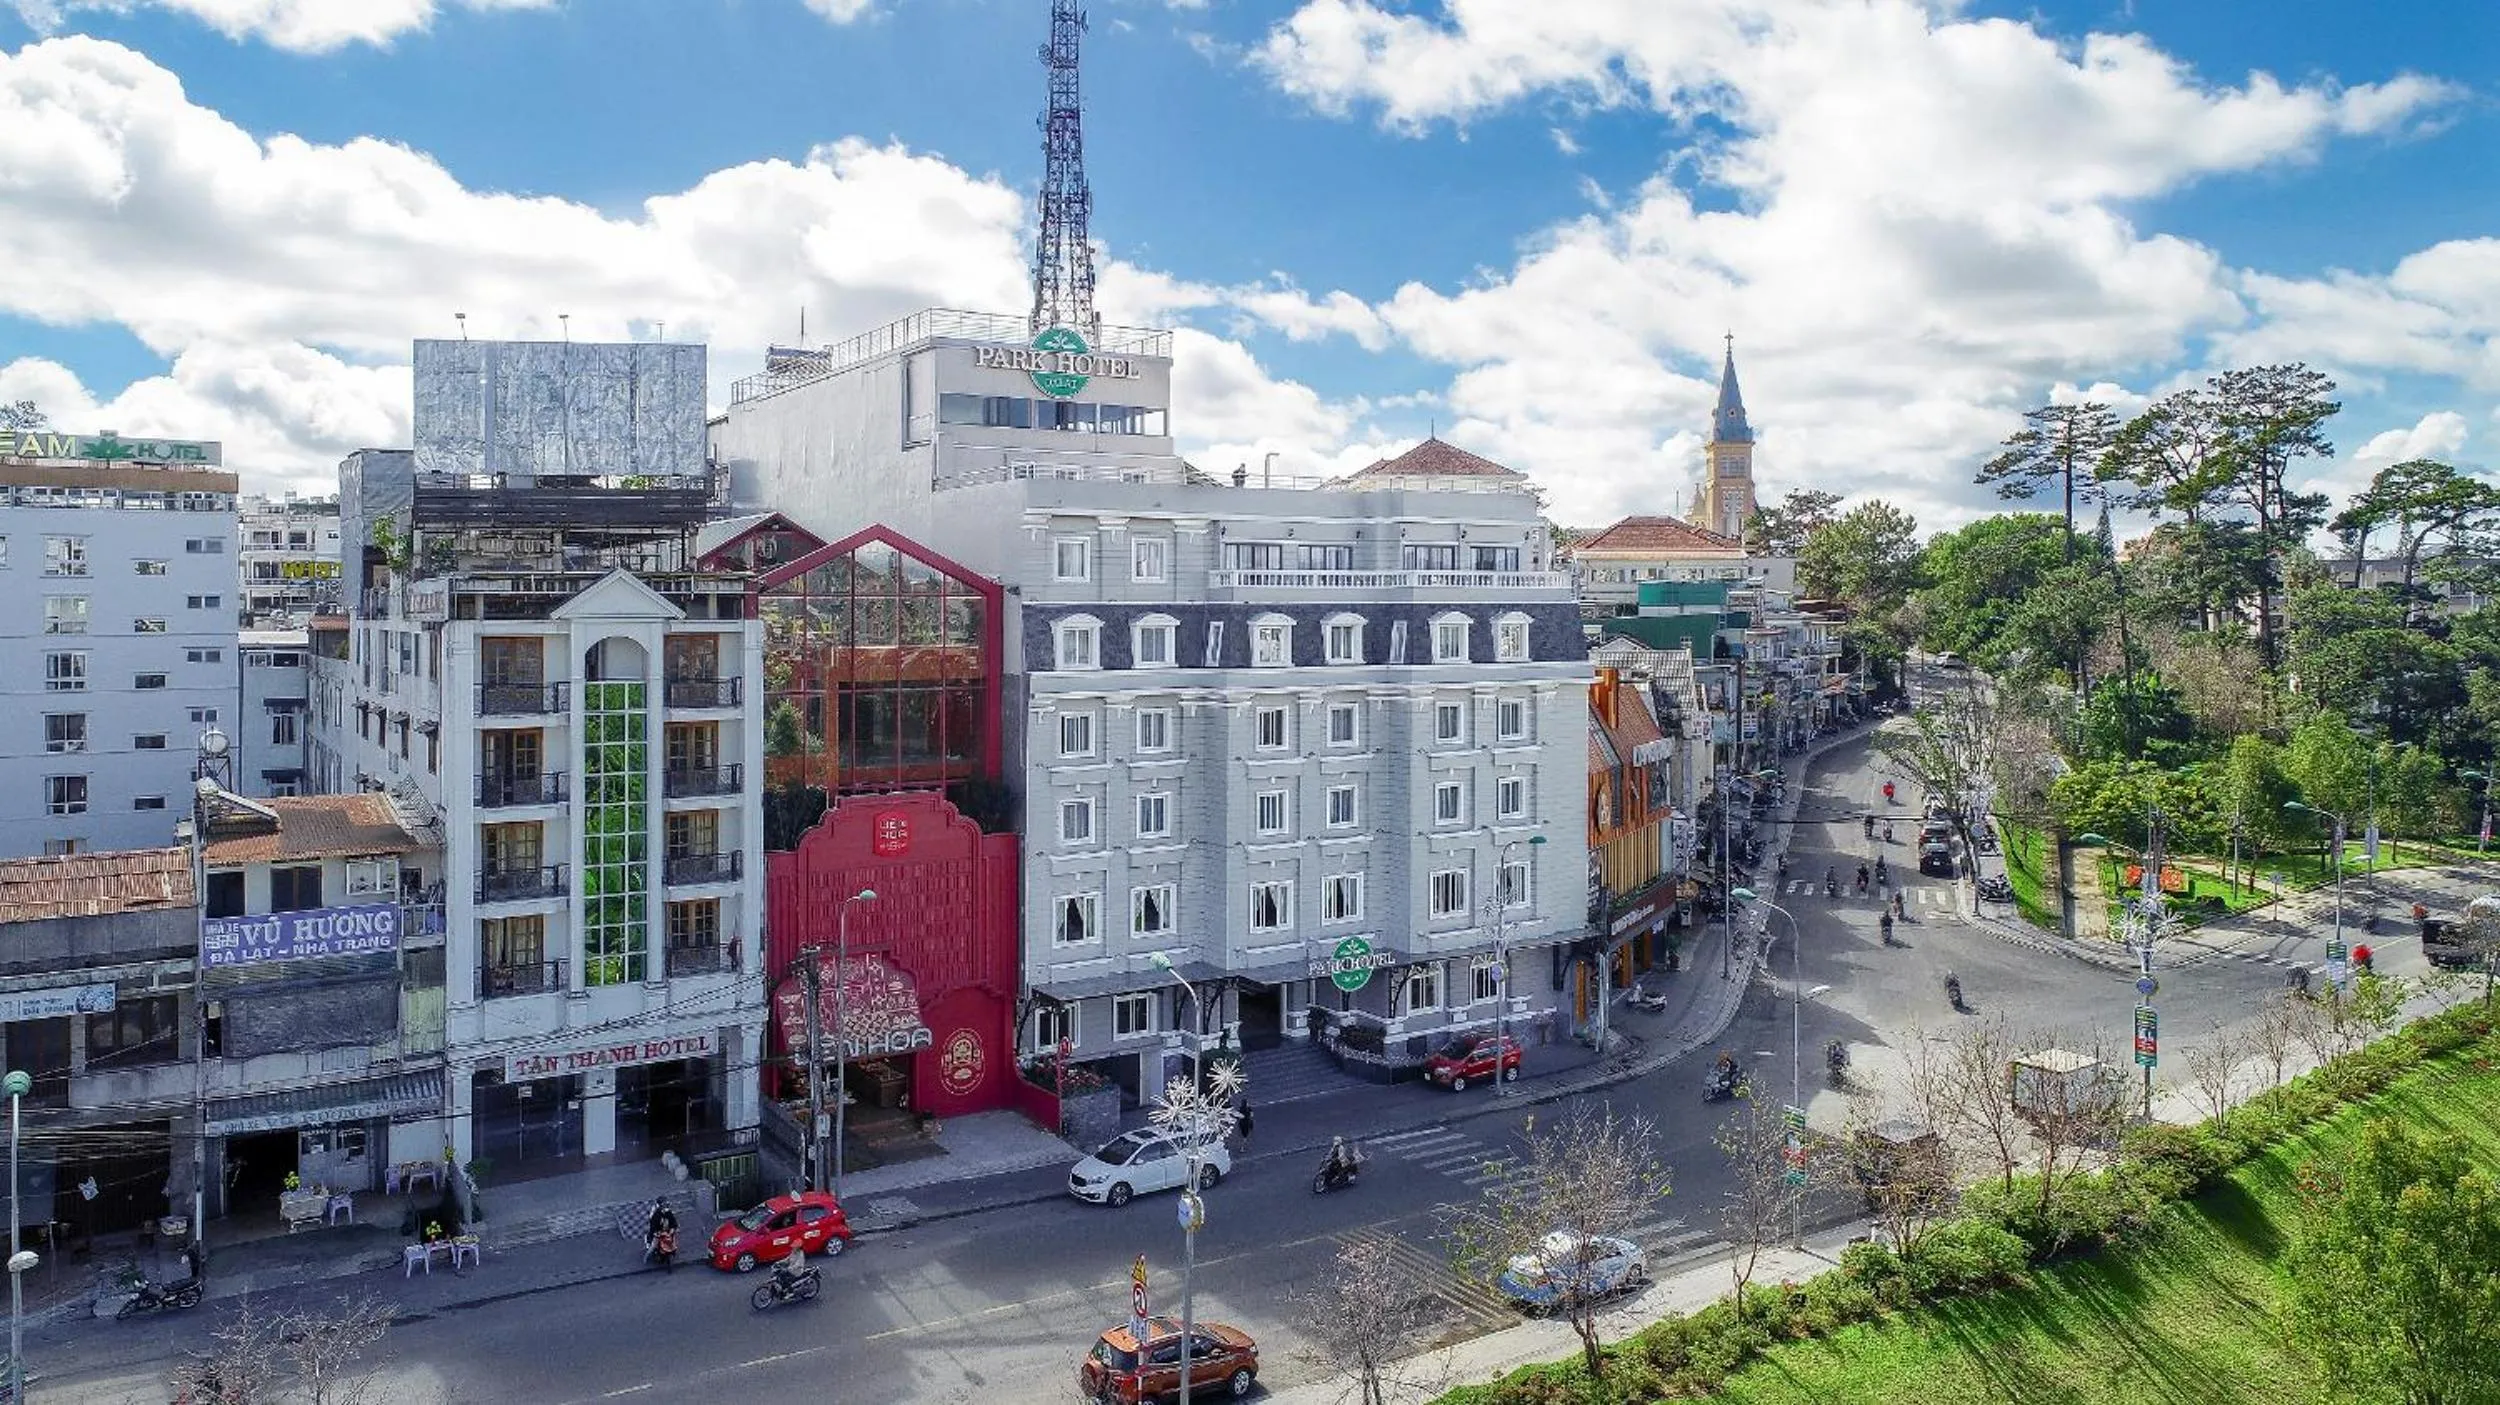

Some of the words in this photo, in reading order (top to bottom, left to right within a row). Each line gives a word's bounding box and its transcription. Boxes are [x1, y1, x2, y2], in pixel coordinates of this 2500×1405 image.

[975, 346, 1046, 371] PARK
[1055, 351, 1141, 379] HOTEL
[137, 443, 207, 461] HOTEL
[292, 911, 395, 942] HƯƠNG
[293, 942, 329, 954] NHA
[335, 936, 391, 950] TRANG
[643, 1036, 710, 1060] HOTEL
[868, 1028, 932, 1055] HOA
